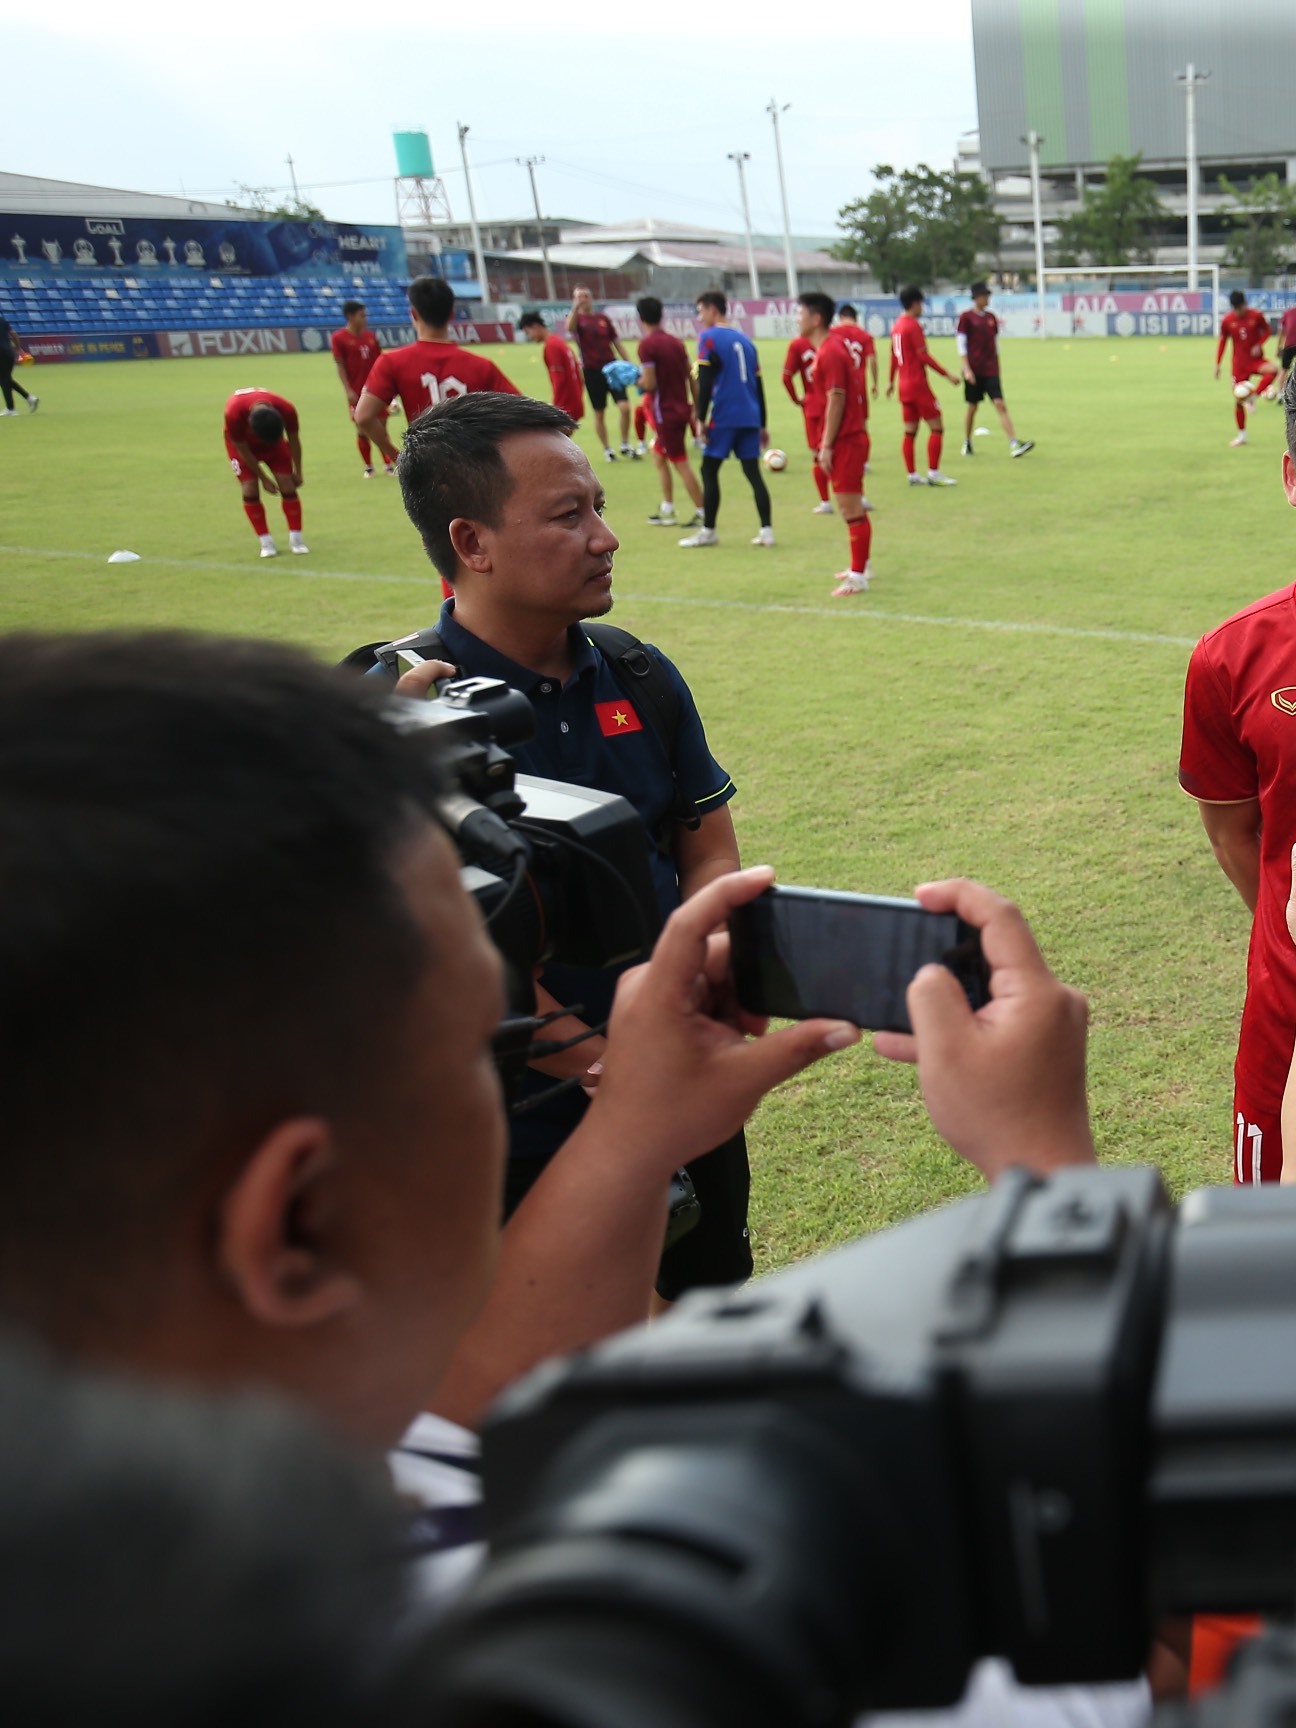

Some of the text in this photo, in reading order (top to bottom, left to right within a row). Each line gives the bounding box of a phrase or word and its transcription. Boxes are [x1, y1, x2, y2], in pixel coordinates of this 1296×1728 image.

[338, 233, 387, 251] HEART
[342, 260, 382, 275] PATH
[1074, 294, 1119, 313] AIA
[1142, 293, 1190, 312] AIA
[1139, 314, 1213, 335] ISI PIP
[732, 340, 749, 384] 1
[1236, 1111, 1263, 1188] 11
